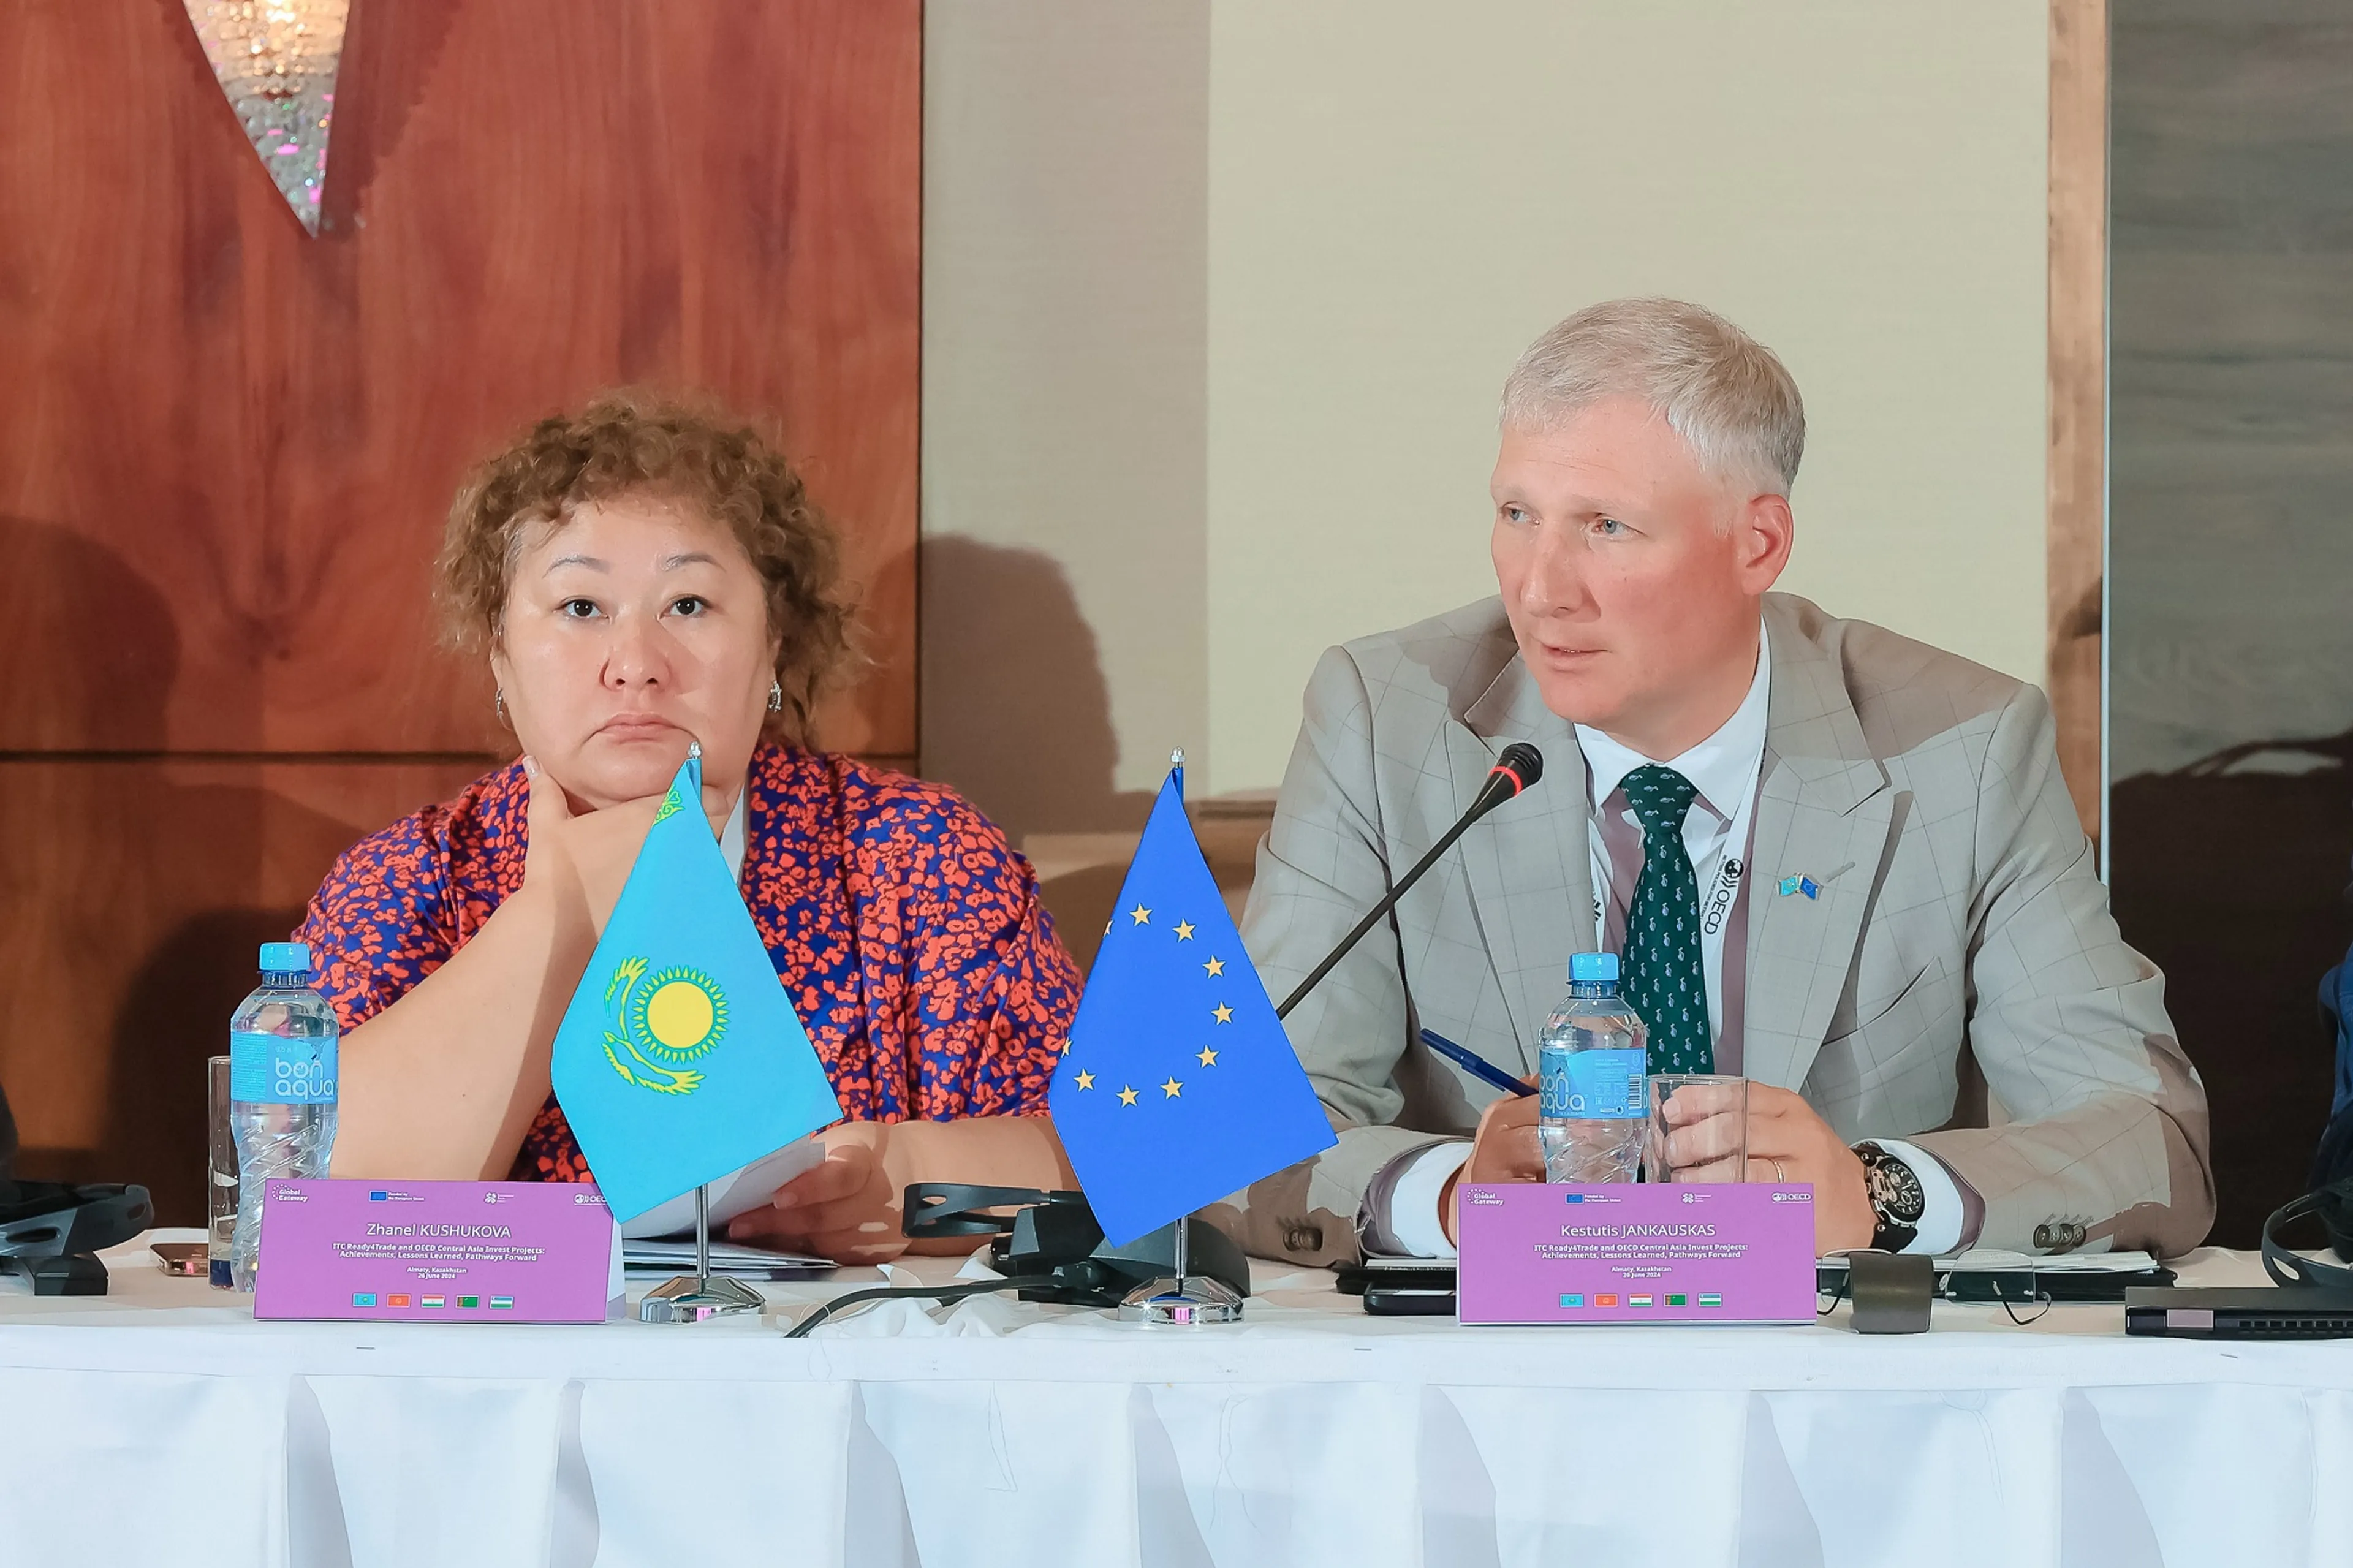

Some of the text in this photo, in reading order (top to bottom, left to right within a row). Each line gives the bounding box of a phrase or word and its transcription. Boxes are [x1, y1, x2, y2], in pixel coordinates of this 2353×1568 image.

[1705, 890, 1730, 934] OECD
[276, 1057, 323, 1078] bon
[275, 1078, 334, 1100] aqua
[367, 1223, 511, 1237] Zhanel KUSHUKOVA
[1561, 1224, 1716, 1238] Kestutis JANKAUSKAS
[1715, 1244, 1748, 1252] Projects:
[466, 1253, 503, 1262] Pathways
